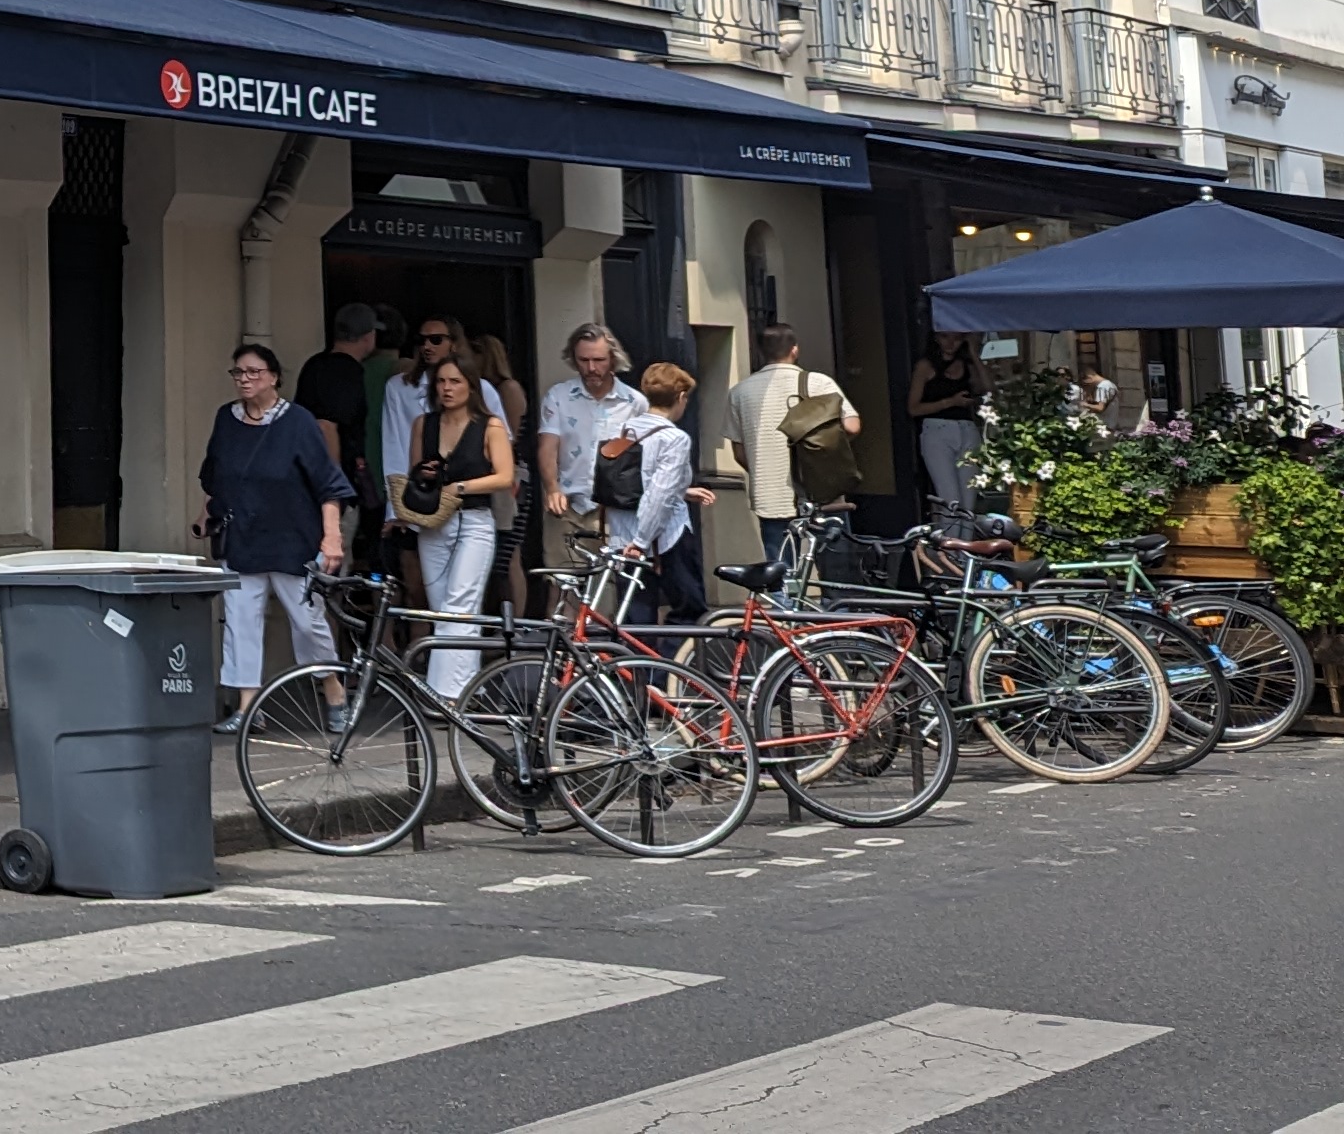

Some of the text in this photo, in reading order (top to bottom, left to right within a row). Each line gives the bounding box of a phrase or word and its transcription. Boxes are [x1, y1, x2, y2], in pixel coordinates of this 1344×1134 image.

[197, 72, 378, 126] BREIZH CAFE
[739, 146, 753, 158] LA
[792, 151, 851, 167] AUTREMENT
[348, 218, 523, 245] LA CRÊPE AUTREMENT
[162, 678, 192, 693] PARIS
